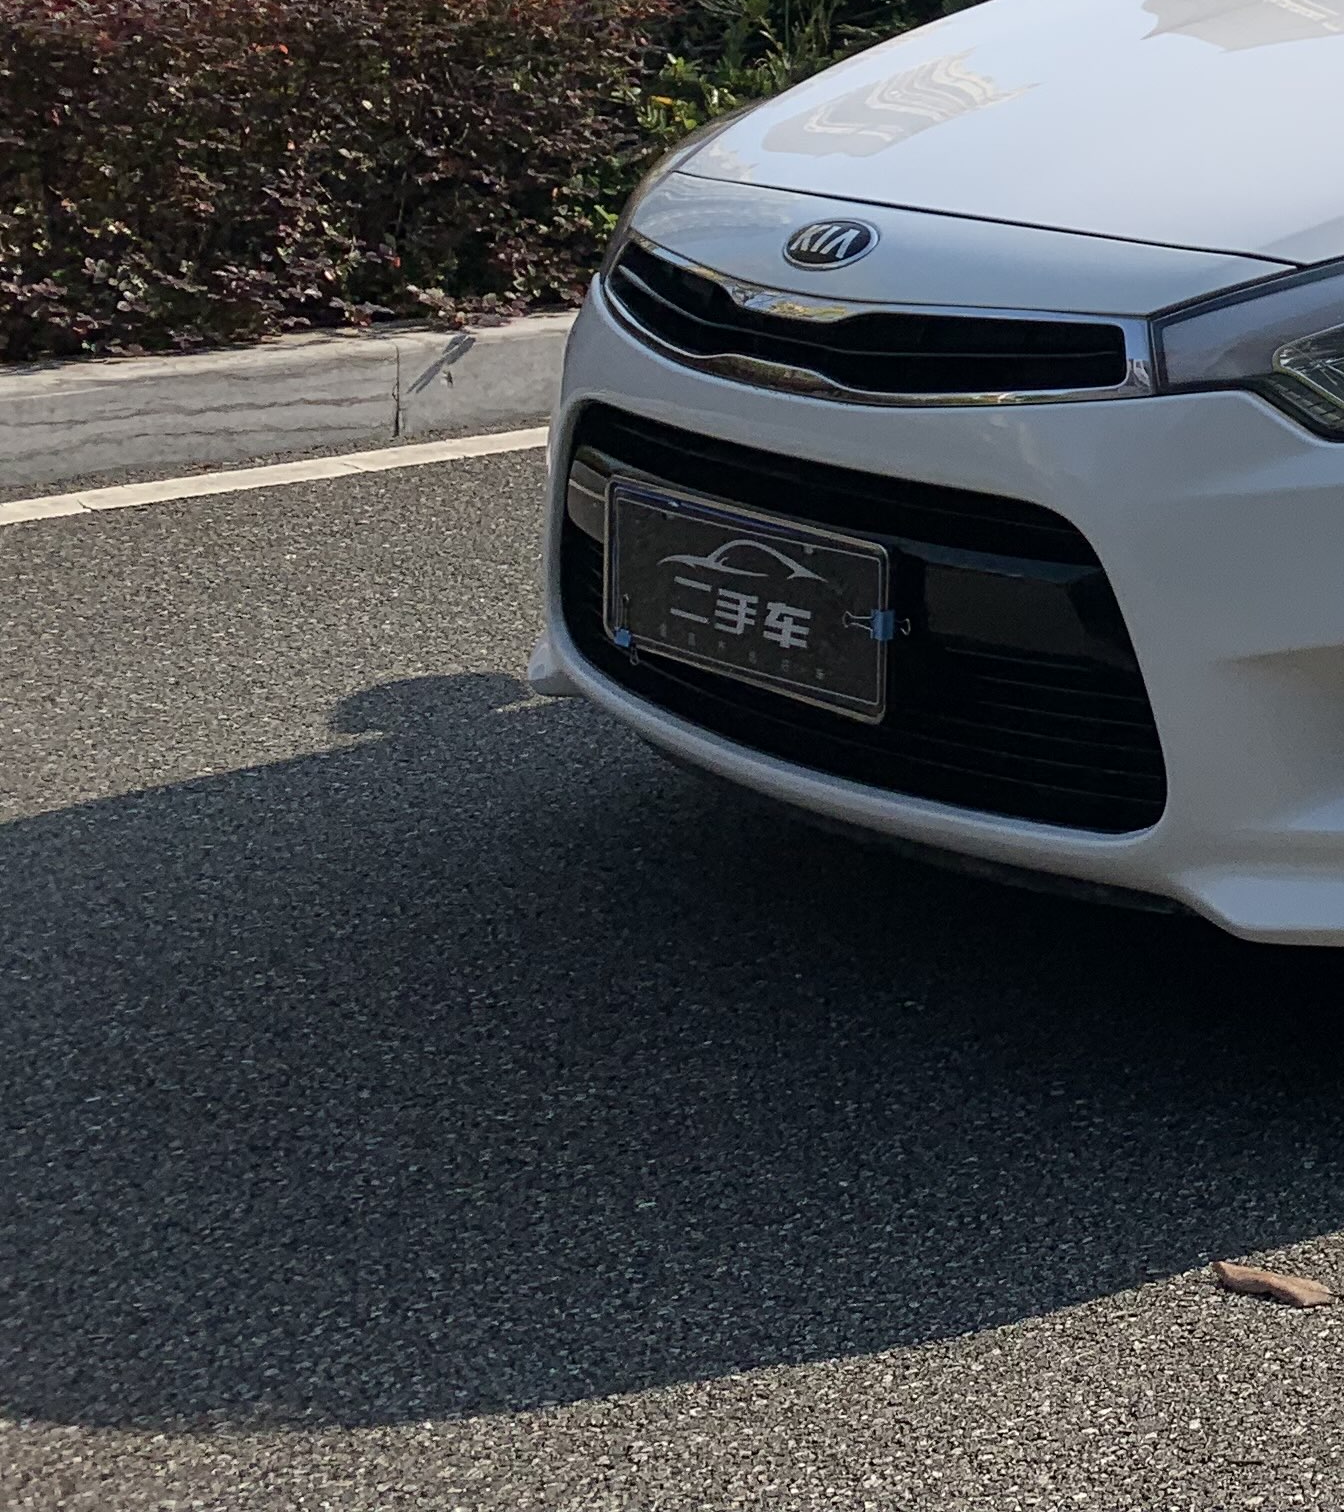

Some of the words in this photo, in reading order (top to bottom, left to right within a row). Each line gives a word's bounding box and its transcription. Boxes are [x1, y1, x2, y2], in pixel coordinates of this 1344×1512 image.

[789, 224, 861, 259] KIA
[669, 575, 812, 649] 二手车
